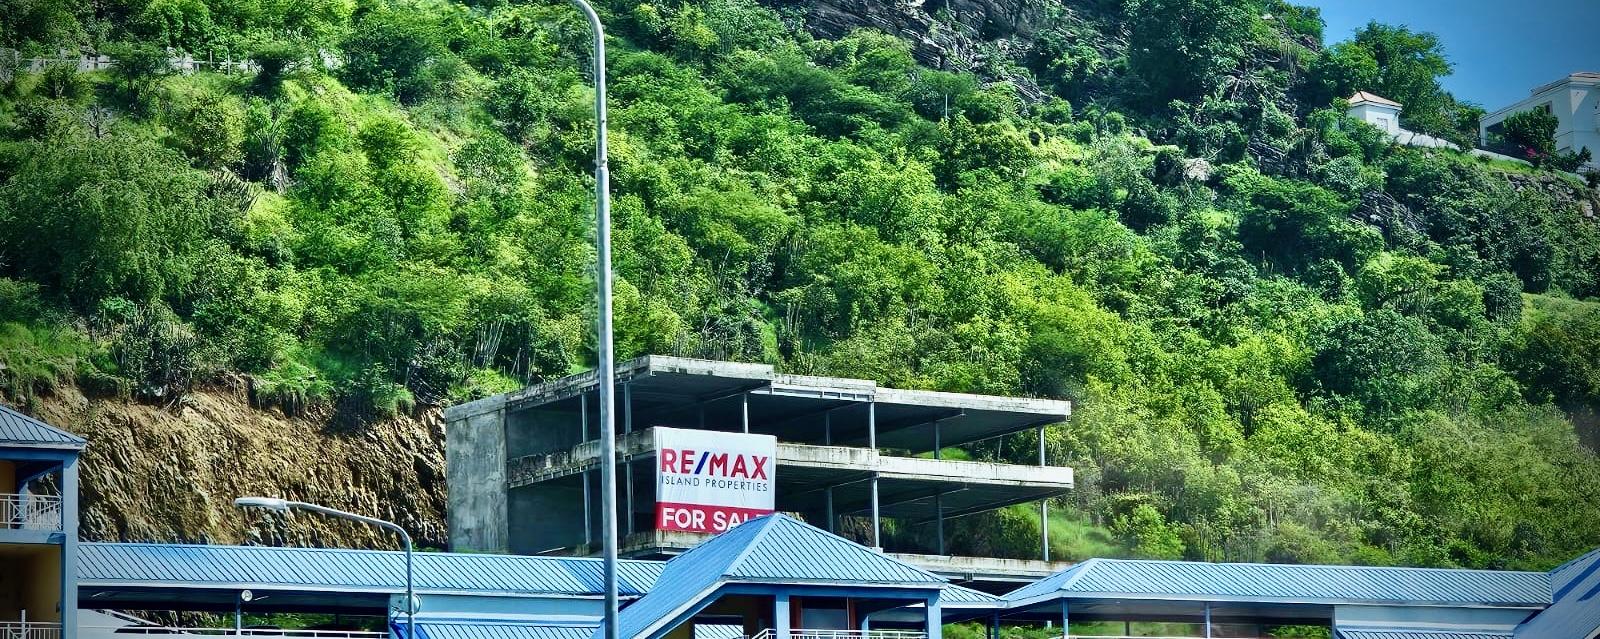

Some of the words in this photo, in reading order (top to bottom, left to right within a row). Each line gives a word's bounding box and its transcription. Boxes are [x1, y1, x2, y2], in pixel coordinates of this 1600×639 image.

[661, 448, 768, 480] RE/MAX
[661, 475, 700, 487] ISLAND
[705, 479, 768, 491] PROPERTIES
[662, 507, 706, 530] FOR
[712, 511, 768, 531] SA
